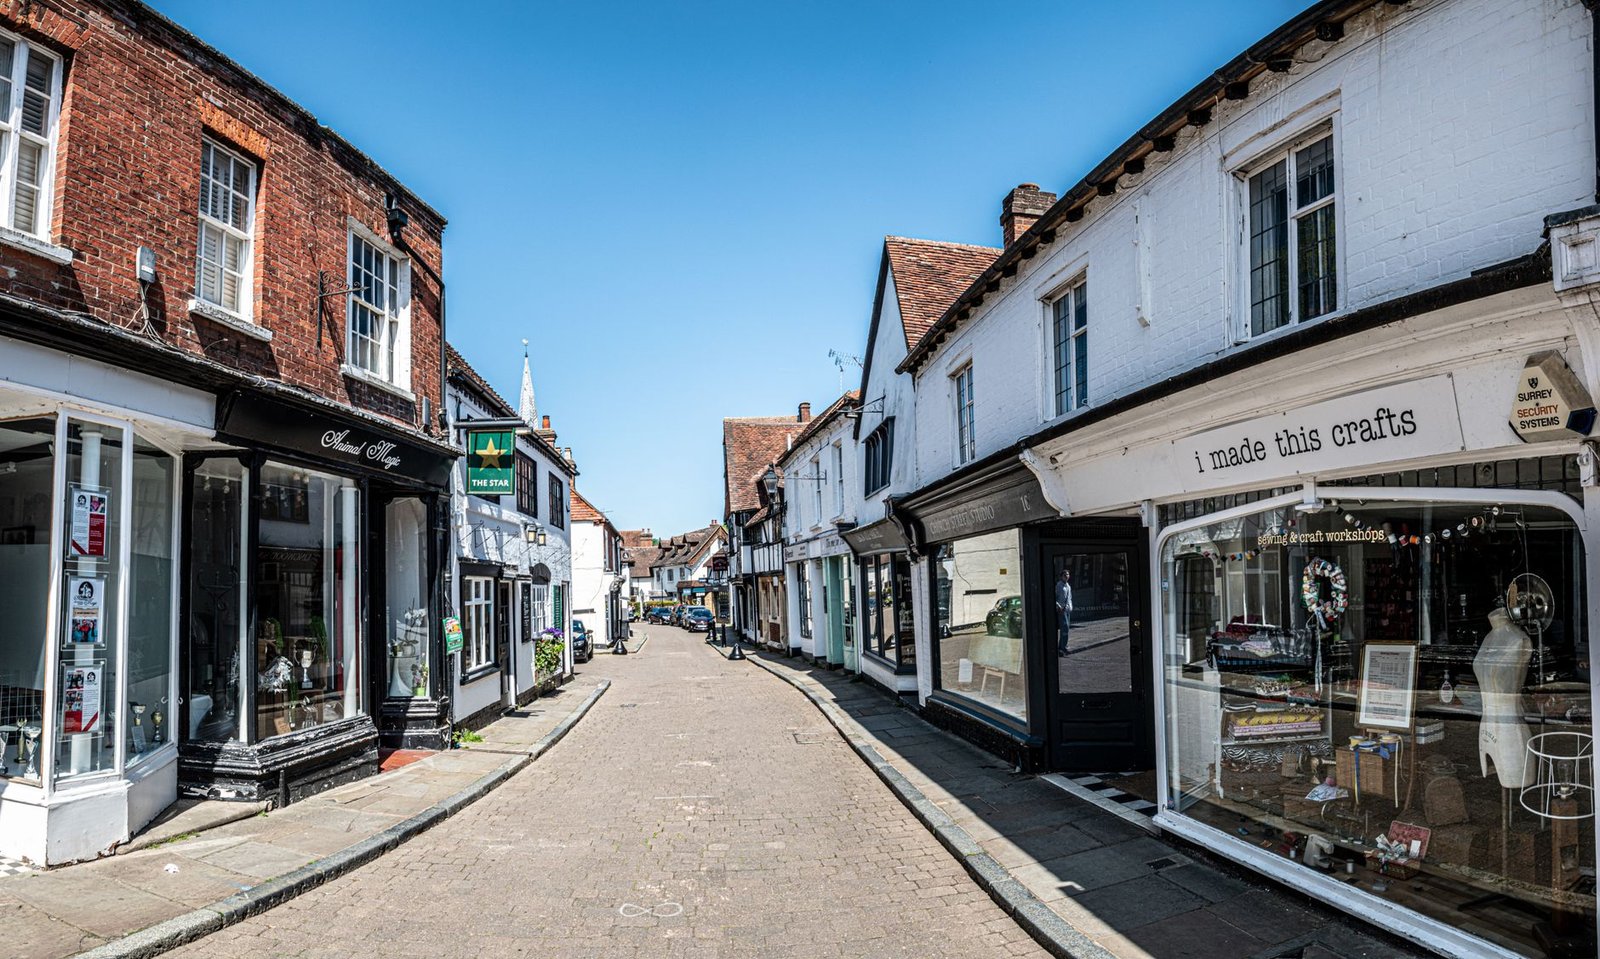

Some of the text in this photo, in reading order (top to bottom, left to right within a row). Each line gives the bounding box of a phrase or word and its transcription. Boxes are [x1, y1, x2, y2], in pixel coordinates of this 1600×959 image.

[1517, 389, 1553, 402] SURREY
[1517, 404, 1559, 418] SECURITY
[1519, 416, 1560, 430] SYSTEMS
[1195, 408, 1417, 473] i made this crafts
[321, 429, 400, 470] Animal Magic
[471, 479, 509, 487] THE STAR
[970, 504, 995, 524] STUDIO
[1257, 528, 1385, 546] sewing & craft workshops
